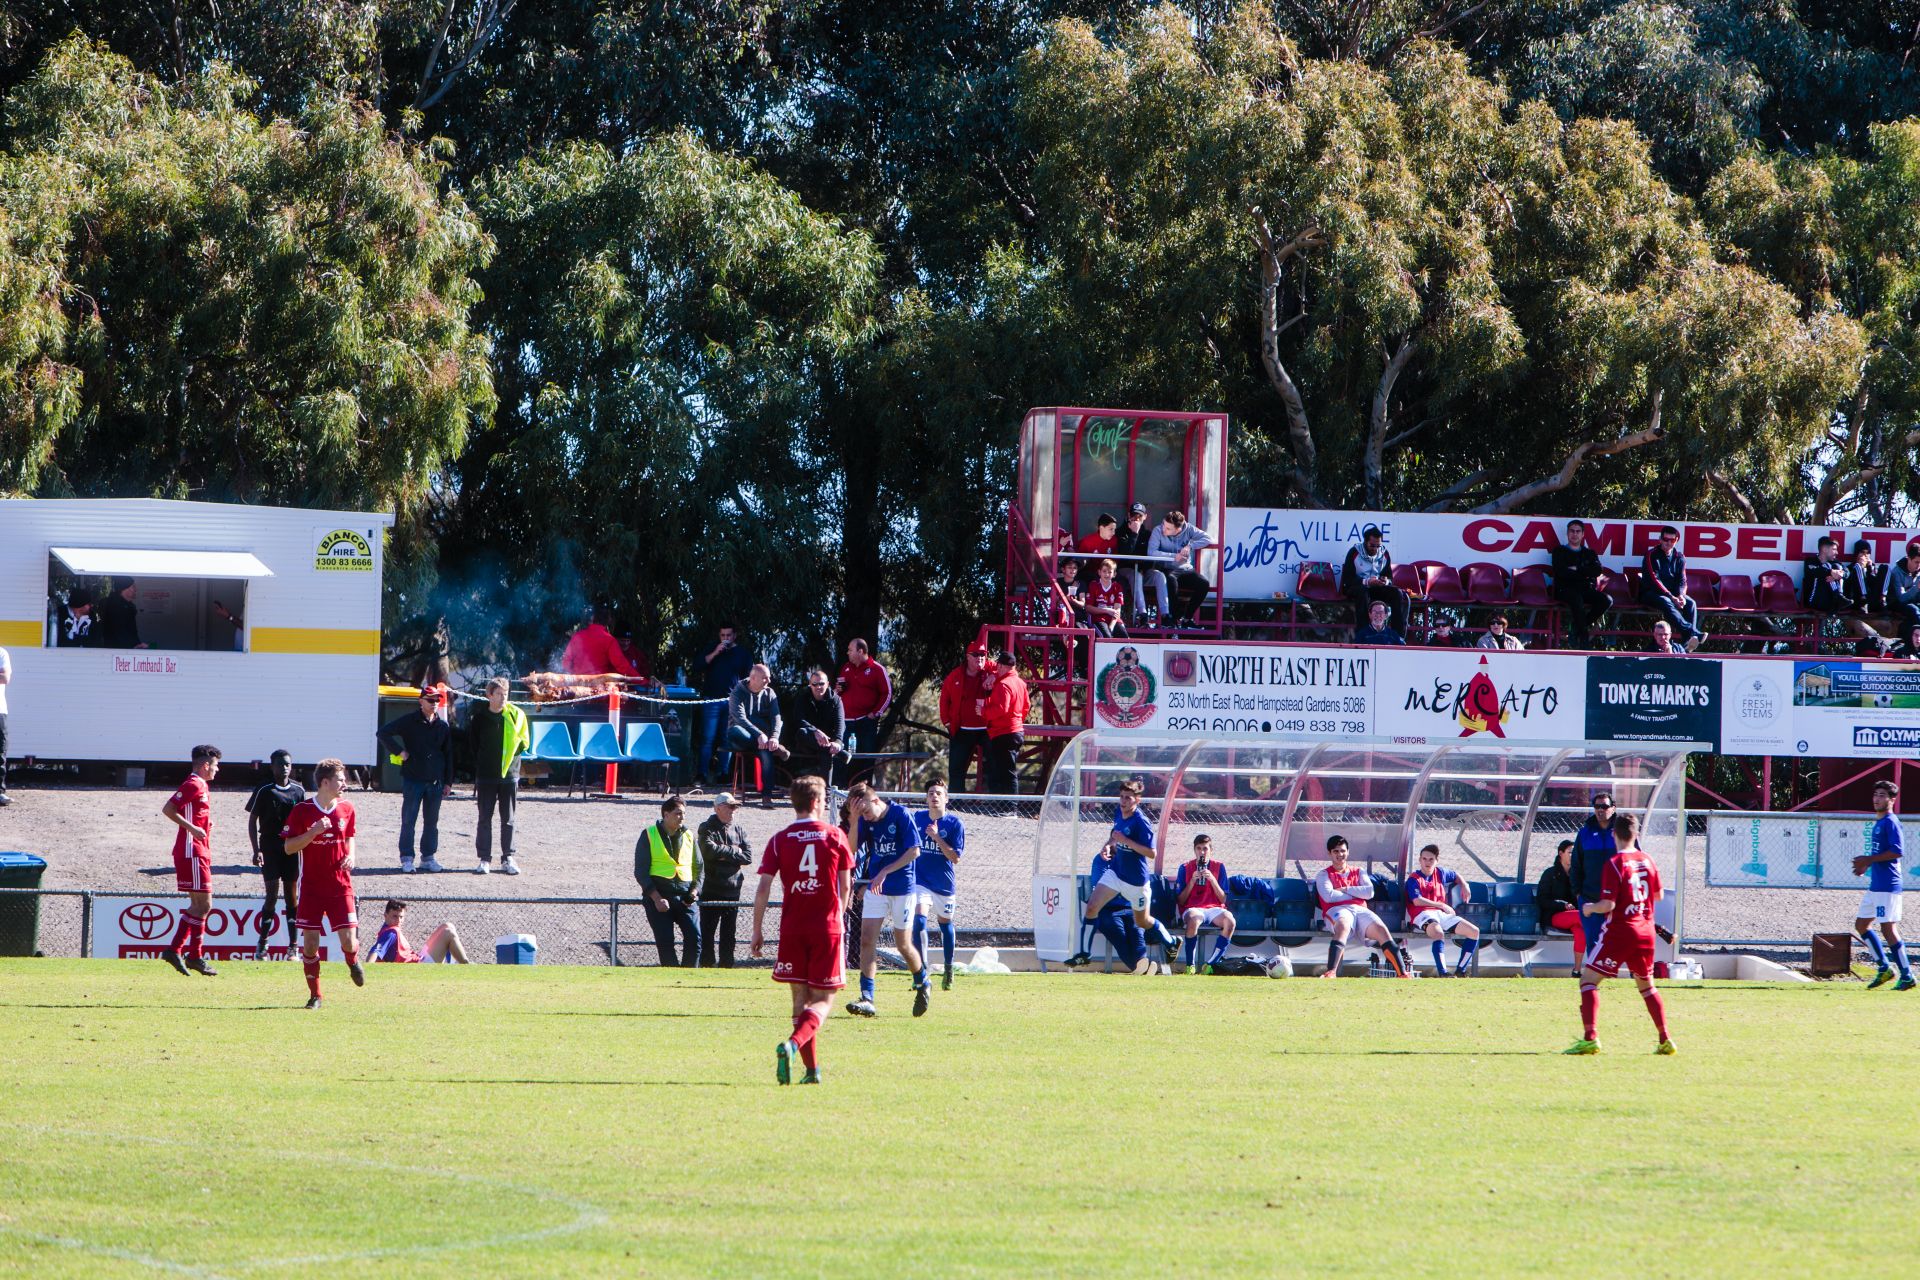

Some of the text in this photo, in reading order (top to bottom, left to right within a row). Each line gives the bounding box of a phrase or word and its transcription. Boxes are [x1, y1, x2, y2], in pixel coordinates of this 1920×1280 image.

[321, 532, 365, 550] BIANCO
[1224, 511, 1309, 572] ewton
[1462, 518, 1920, 565] CAMPBELLT
[333, 548, 355, 556] HIRE
[316, 558, 372, 566] 1300 83 6666
[115, 657, 176, 673] Peter Lombardi Bar
[1199, 655, 1264, 685] NORTH
[1269, 656, 1320, 686] EAST
[1325, 658, 1369, 687] FIAT
[1860, 674, 1868, 682] BE
[1869, 674, 1895, 683] KICKING
[1895, 675, 1916, 683] GOALS
[1168, 692, 1365, 714] 253 North East Road Hampstead Gardens 5086
[1742, 699, 1773, 708] FRESH
[1635, 714, 1651, 722] FAMILY
[1652, 713, 1678, 722] TRADITION
[1742, 708, 1773, 718] STEMS
[1276, 719, 1305, 732] 0419
[1309, 720, 1336, 733] 838
[1341, 721, 1365, 733] 798
[1393, 736, 1427, 744] VISITORS
[1613, 733, 1694, 741] www.tonyandmarks.com.au
[799, 844, 818, 877] 4
[1628, 871, 1649, 902] 15
[1876, 905, 1885, 917] 18
[180, 907, 327, 937] OYO
